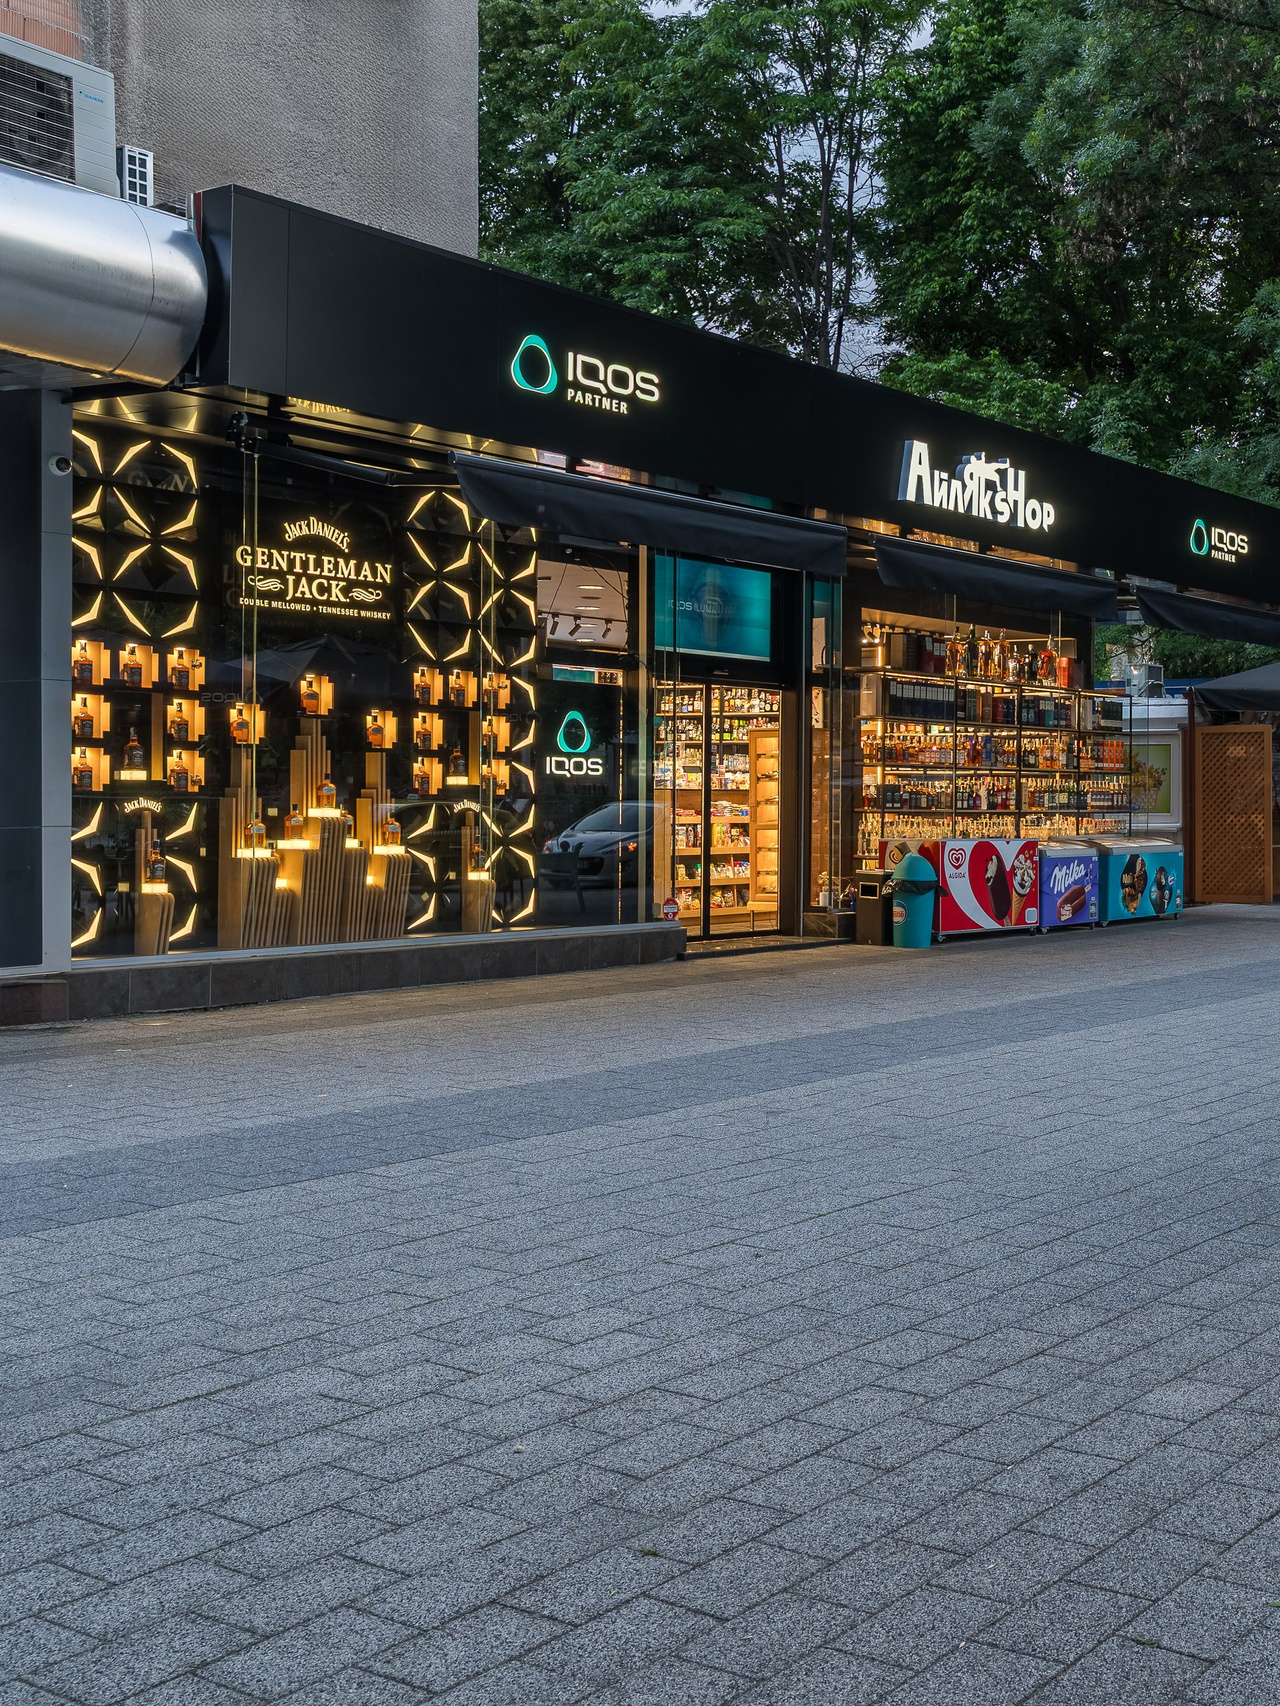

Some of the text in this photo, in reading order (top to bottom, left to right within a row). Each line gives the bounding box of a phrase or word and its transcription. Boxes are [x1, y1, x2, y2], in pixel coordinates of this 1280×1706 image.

[567, 351, 660, 402] IQOS
[567, 388, 628, 414] PARTNER
[283, 520, 309, 542] JACK
[1211, 526, 1249, 554] IQOS
[235, 545, 392, 584] GENTLEMAN
[1211, 549, 1236, 563] PARTNER
[239, 597, 391, 620] DOUBLE MELLOWED TENNESSEE WHISKEY
[545, 756, 603, 778] IQOS
[124, 800, 139, 814] JACK
[948, 872, 967, 880] ALGIDA
[1050, 859, 1087, 895] Milka
